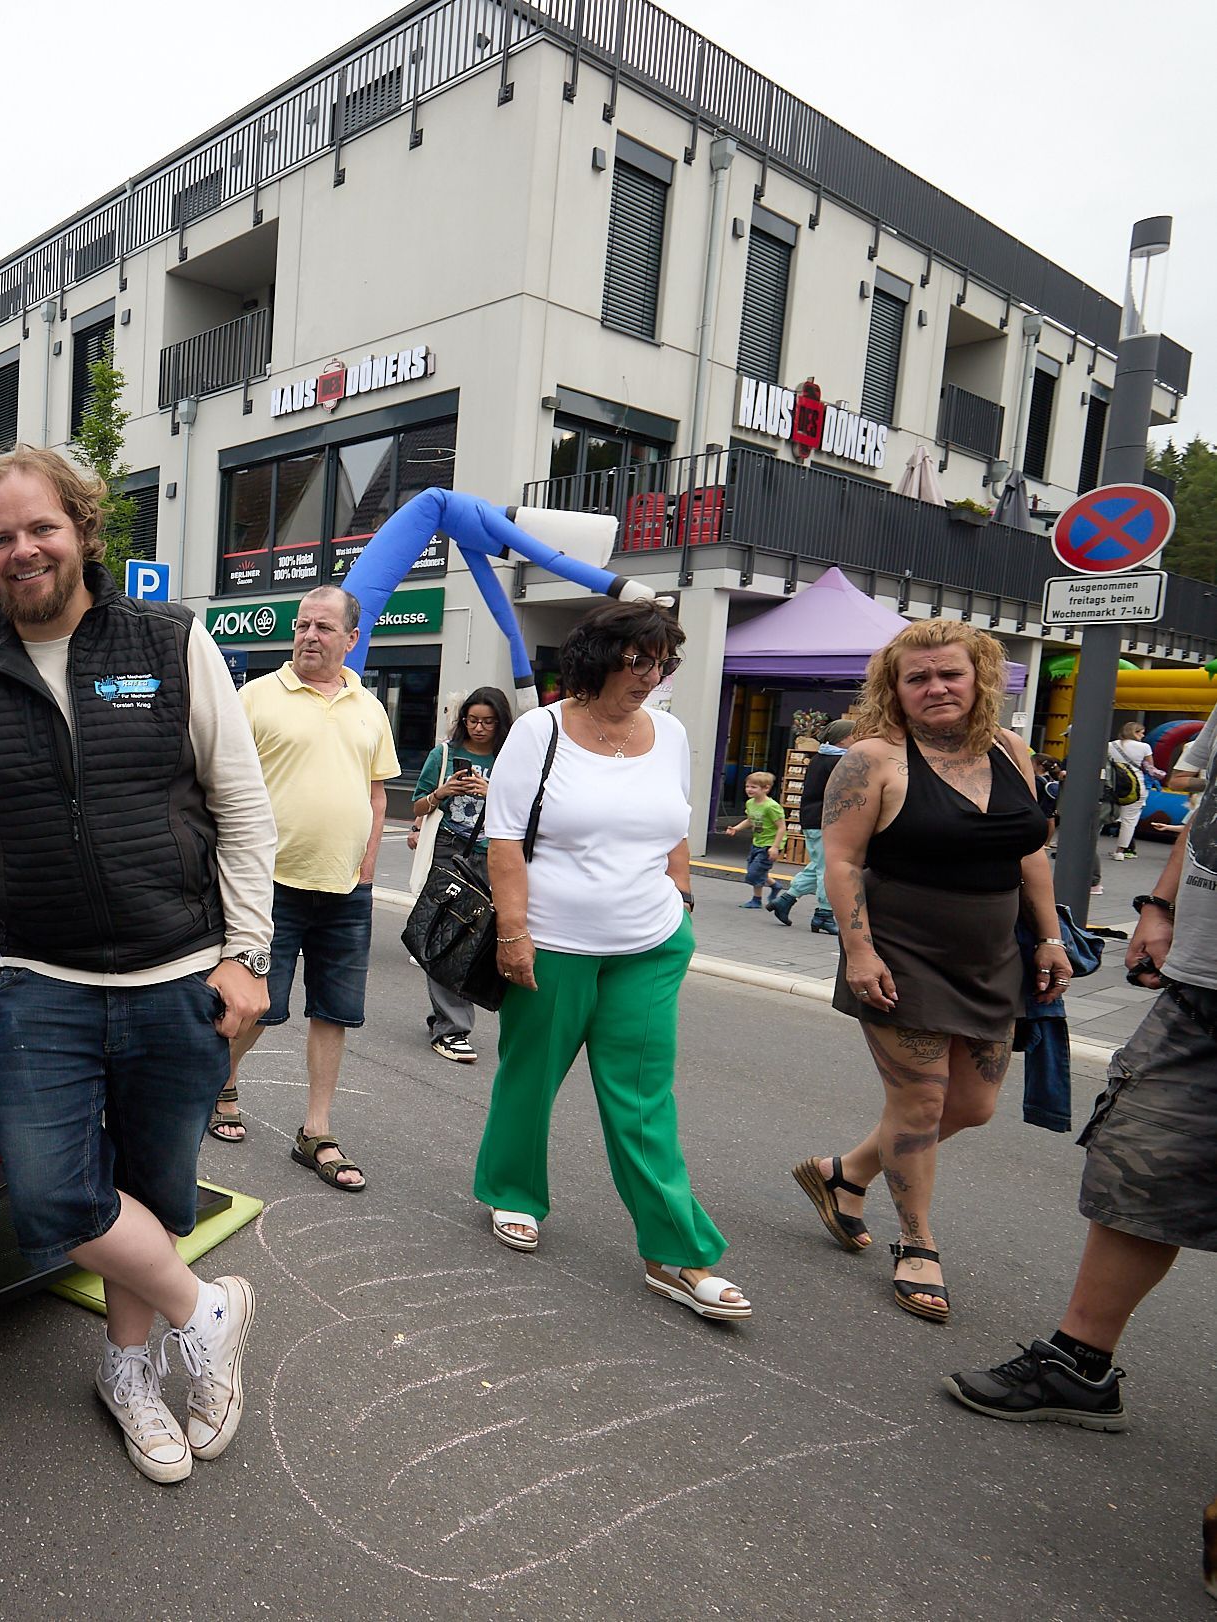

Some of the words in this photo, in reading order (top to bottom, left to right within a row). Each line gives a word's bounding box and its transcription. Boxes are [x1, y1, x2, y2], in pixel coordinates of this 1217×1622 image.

[271, 378, 317, 418] HAUS
[345, 345, 428, 398] DÖNERS
[738, 376, 795, 440] HAUS
[798, 406, 819, 438] DES
[821, 401, 888, 469] DÖNERS
[278, 556, 295, 567] 100%
[296, 552, 314, 565] Halal
[274, 568, 291, 580] 100%
[291, 565, 317, 579] Original
[137, 568, 160, 599] P
[1068, 582, 1139, 593] Ausgenommen
[1069, 596, 1106, 606] freitags
[1110, 594, 1135, 603] beim
[1052, 608, 1116, 618] Wochenmarkt
[211, 611, 254, 636] AOK
